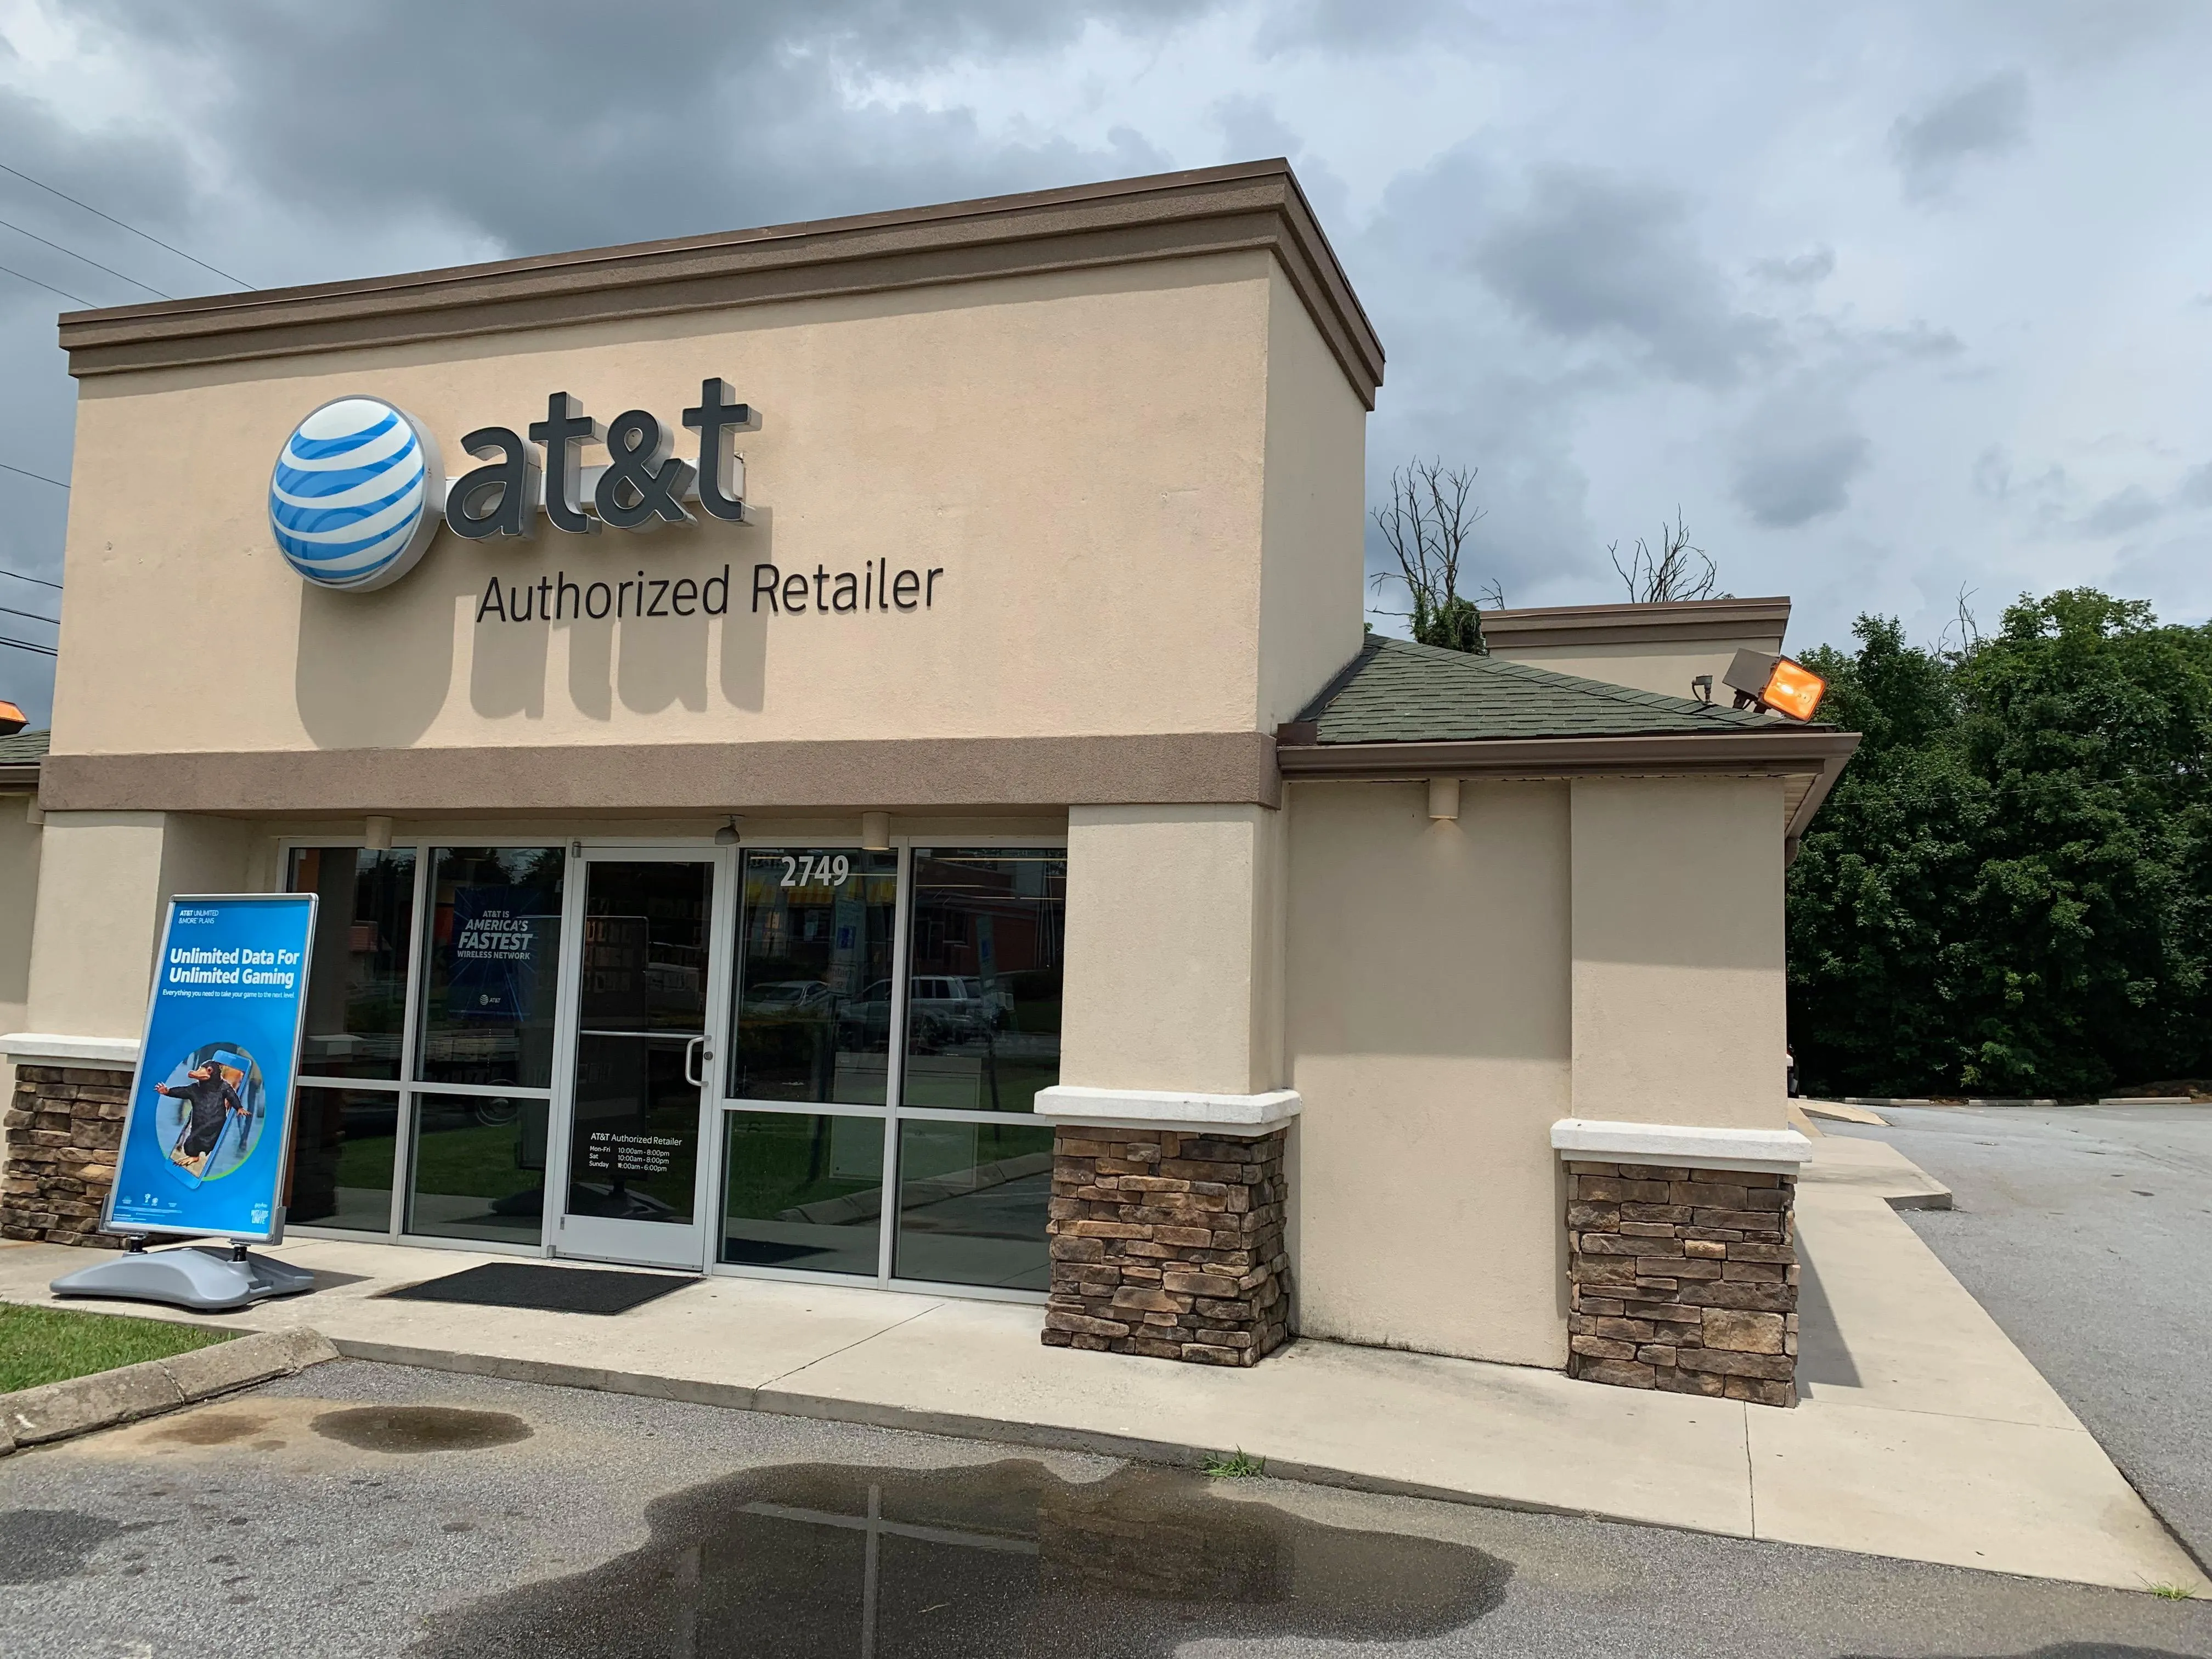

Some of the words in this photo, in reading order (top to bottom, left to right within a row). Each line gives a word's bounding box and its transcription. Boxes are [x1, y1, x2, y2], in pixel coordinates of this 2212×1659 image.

[445, 377, 755, 540] at&t
[476, 564, 730, 623] Authorized
[752, 557, 944, 613] Retailer
[780, 855, 849, 887] 2749
[465, 919, 528, 932] AMERICA'S
[458, 932, 533, 950] FASTEST
[170, 947, 240, 964] Unlimited
[241, 949, 275, 965] Data
[277, 949, 300, 965] For
[457, 950, 492, 958] WIRELESS
[494, 951, 531, 960] NETWORK
[169, 967, 240, 984] Unlimited
[242, 968, 295, 989] Gaming
[162, 989, 191, 997] Everything
[590, 1132, 610, 1141] AT&T
[611, 1134, 652, 1144] Authorized
[653, 1137, 682, 1146] Retailer
[644, 1164, 667, 1172] 6:00pm
